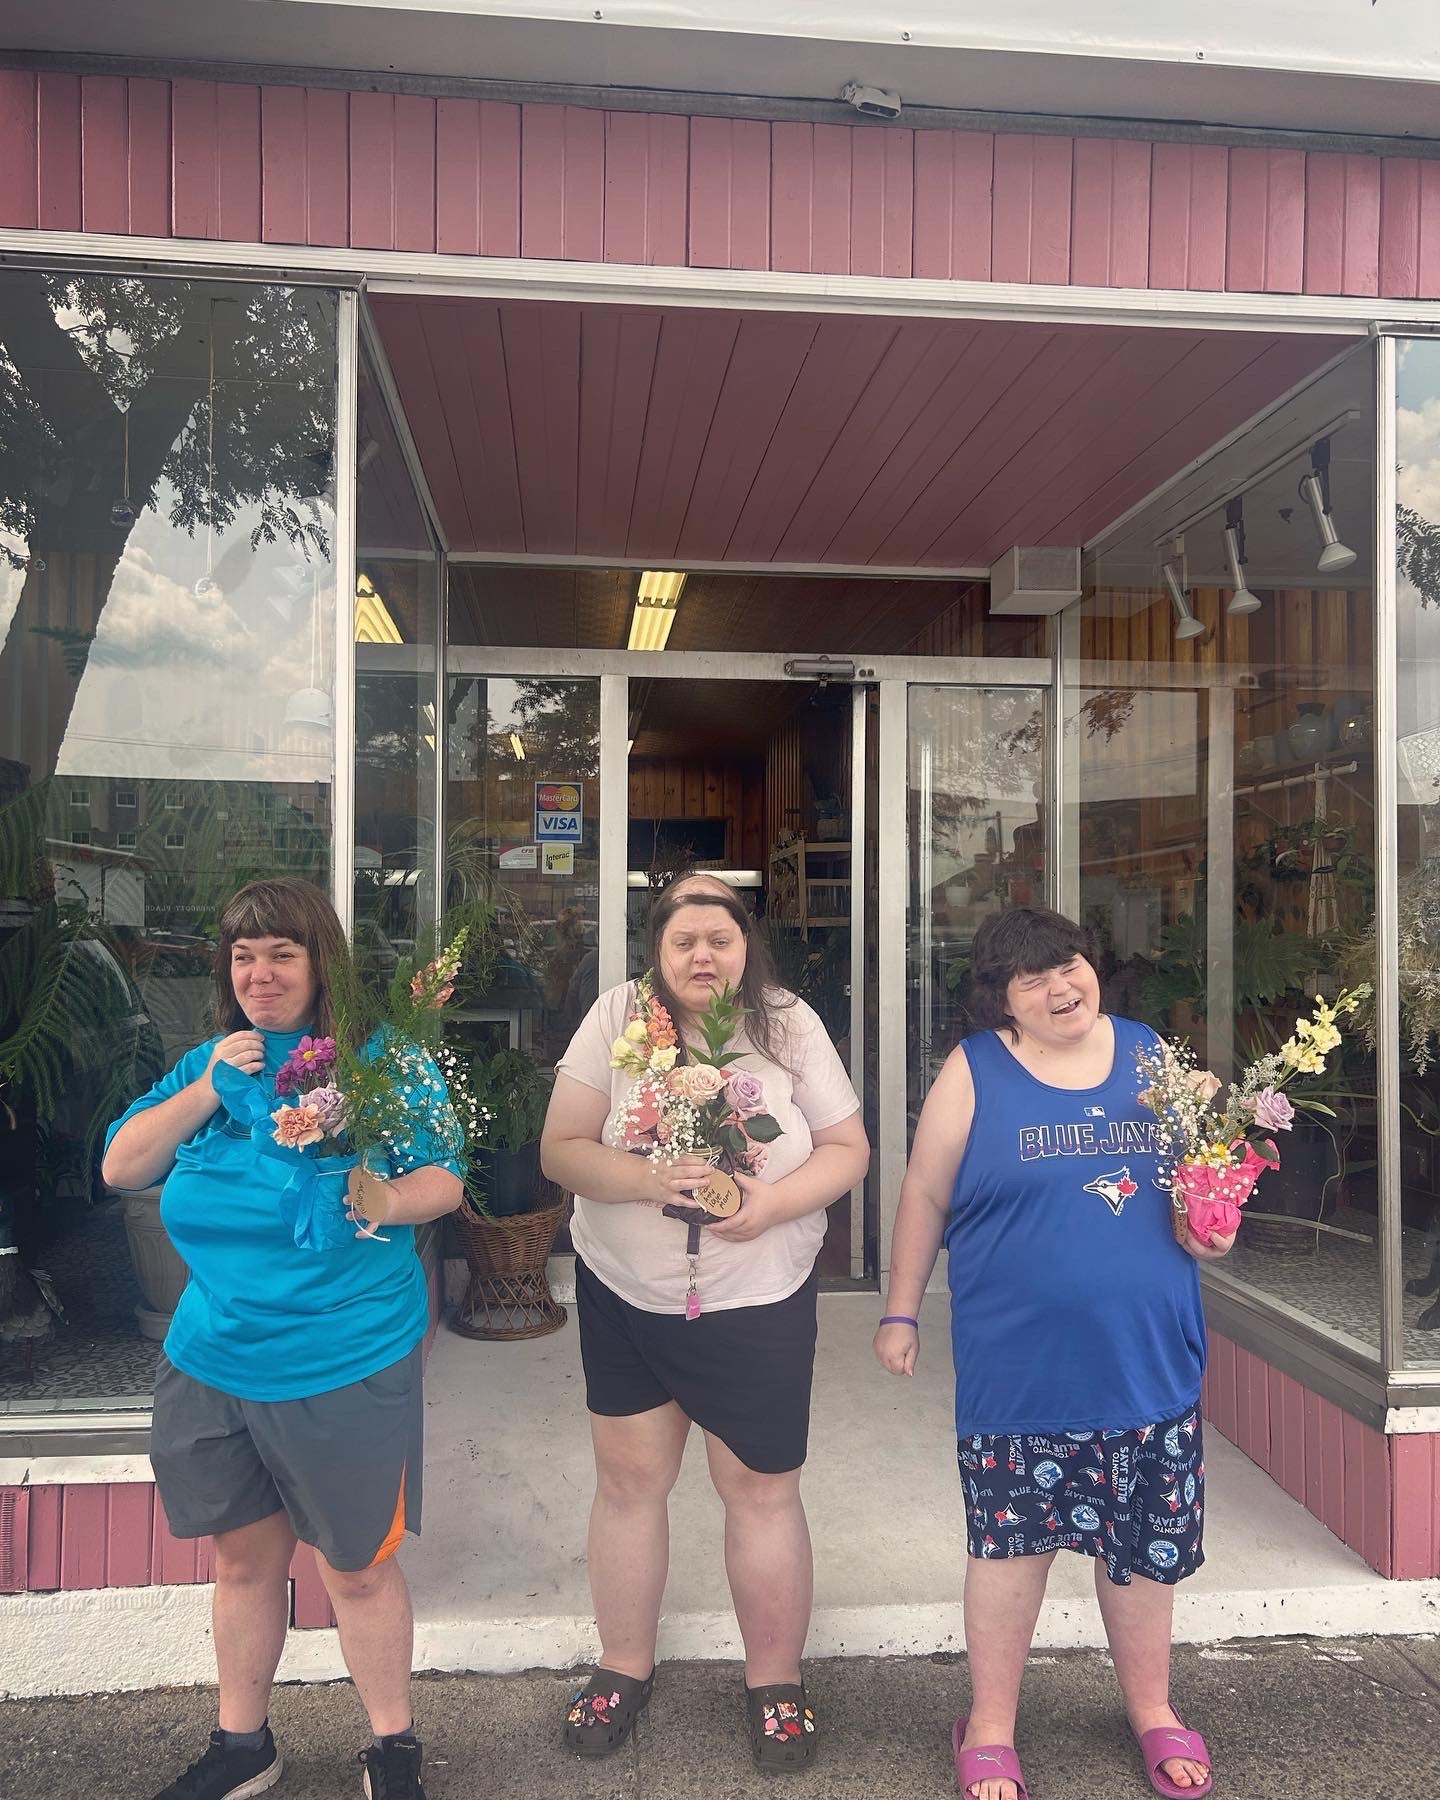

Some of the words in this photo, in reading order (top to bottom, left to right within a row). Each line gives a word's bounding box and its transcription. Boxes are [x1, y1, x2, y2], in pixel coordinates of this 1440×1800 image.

[539, 793, 578, 803] MasterCard
[542, 817, 578, 830] VISA
[546, 852, 570, 862] Interac
[1019, 1123, 1097, 1162] BLUE
[1027, 1435, 1051, 1448] JAYS
[1053, 1442, 1081, 1453] BLUE
[1119, 1446, 1129, 1475] JAYS
[1008, 1486, 1032, 1498] BLUE
[1033, 1487, 1055, 1501] JAYS
[1064, 1489, 1086, 1500] JAYS
[1117, 1476, 1129, 1504] BLUE
[1148, 1512, 1175, 1527] JAYS
[1014, 1533, 1025, 1554] JAYS
